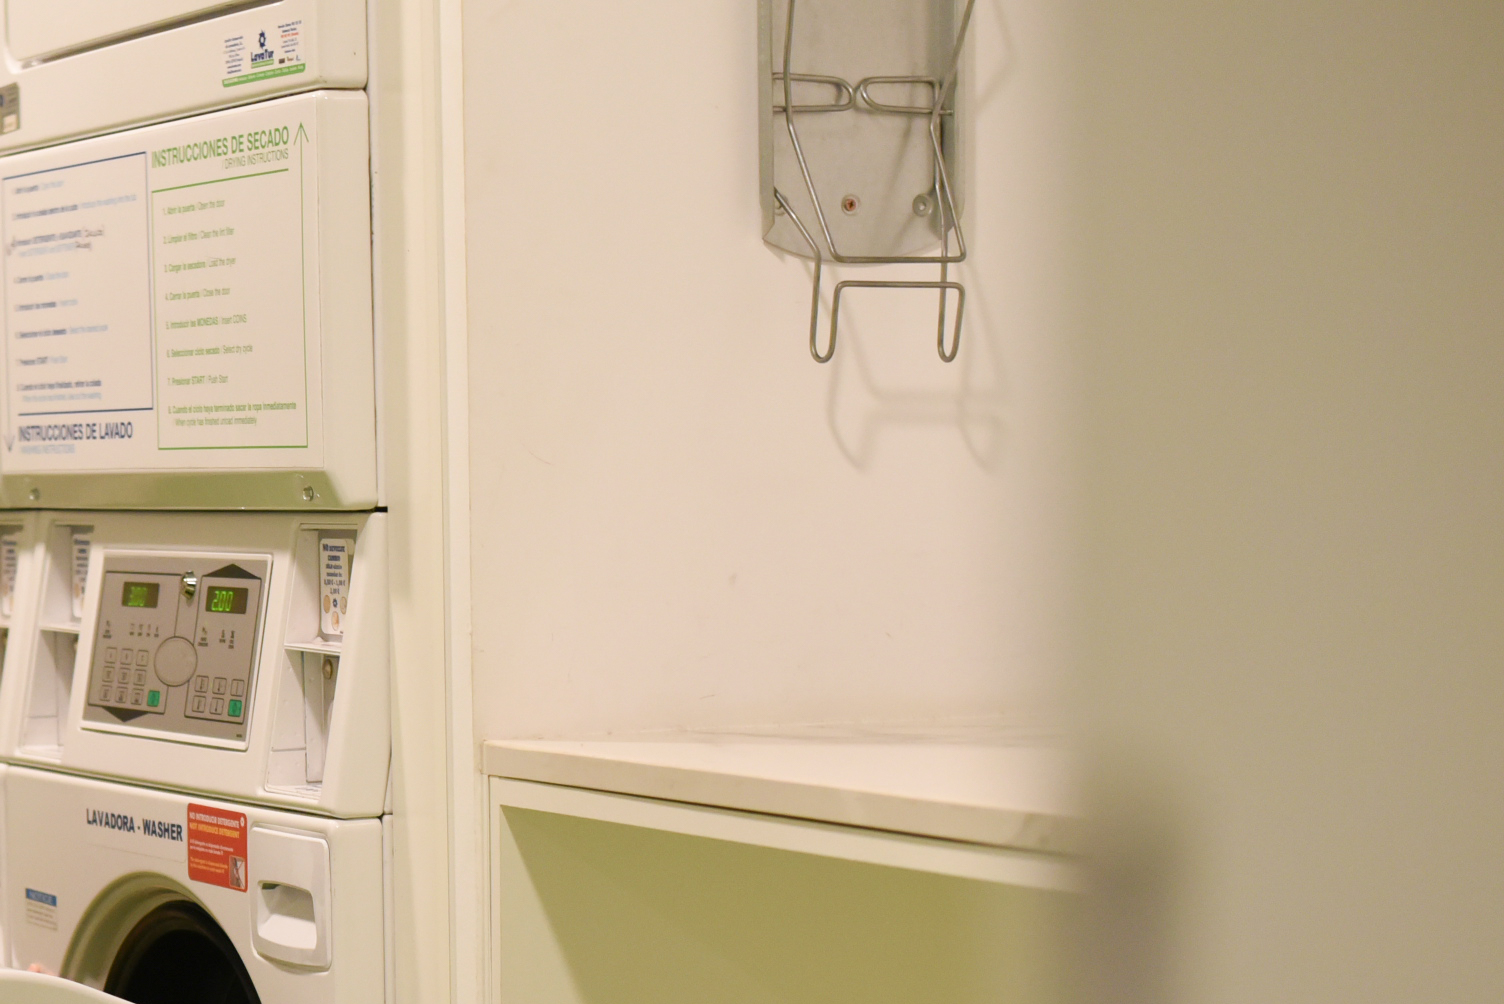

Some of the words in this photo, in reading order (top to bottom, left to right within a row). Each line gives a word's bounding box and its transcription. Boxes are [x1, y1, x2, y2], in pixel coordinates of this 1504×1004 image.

[151, 136, 229, 168] INSTRUCCIONES
[231, 134, 244, 154] DE
[247, 126, 289, 151] SECADO
[225, 155, 246, 169] DRYING
[247, 148, 289, 165] INSTRUCTIONS
[18, 423, 84, 442] INSTRUCCIONES
[86, 423, 97, 440] DE
[99, 421, 133, 440] LAVADO
[86, 808, 135, 833] LAVADORA
[142, 818, 183, 842] WASHER
